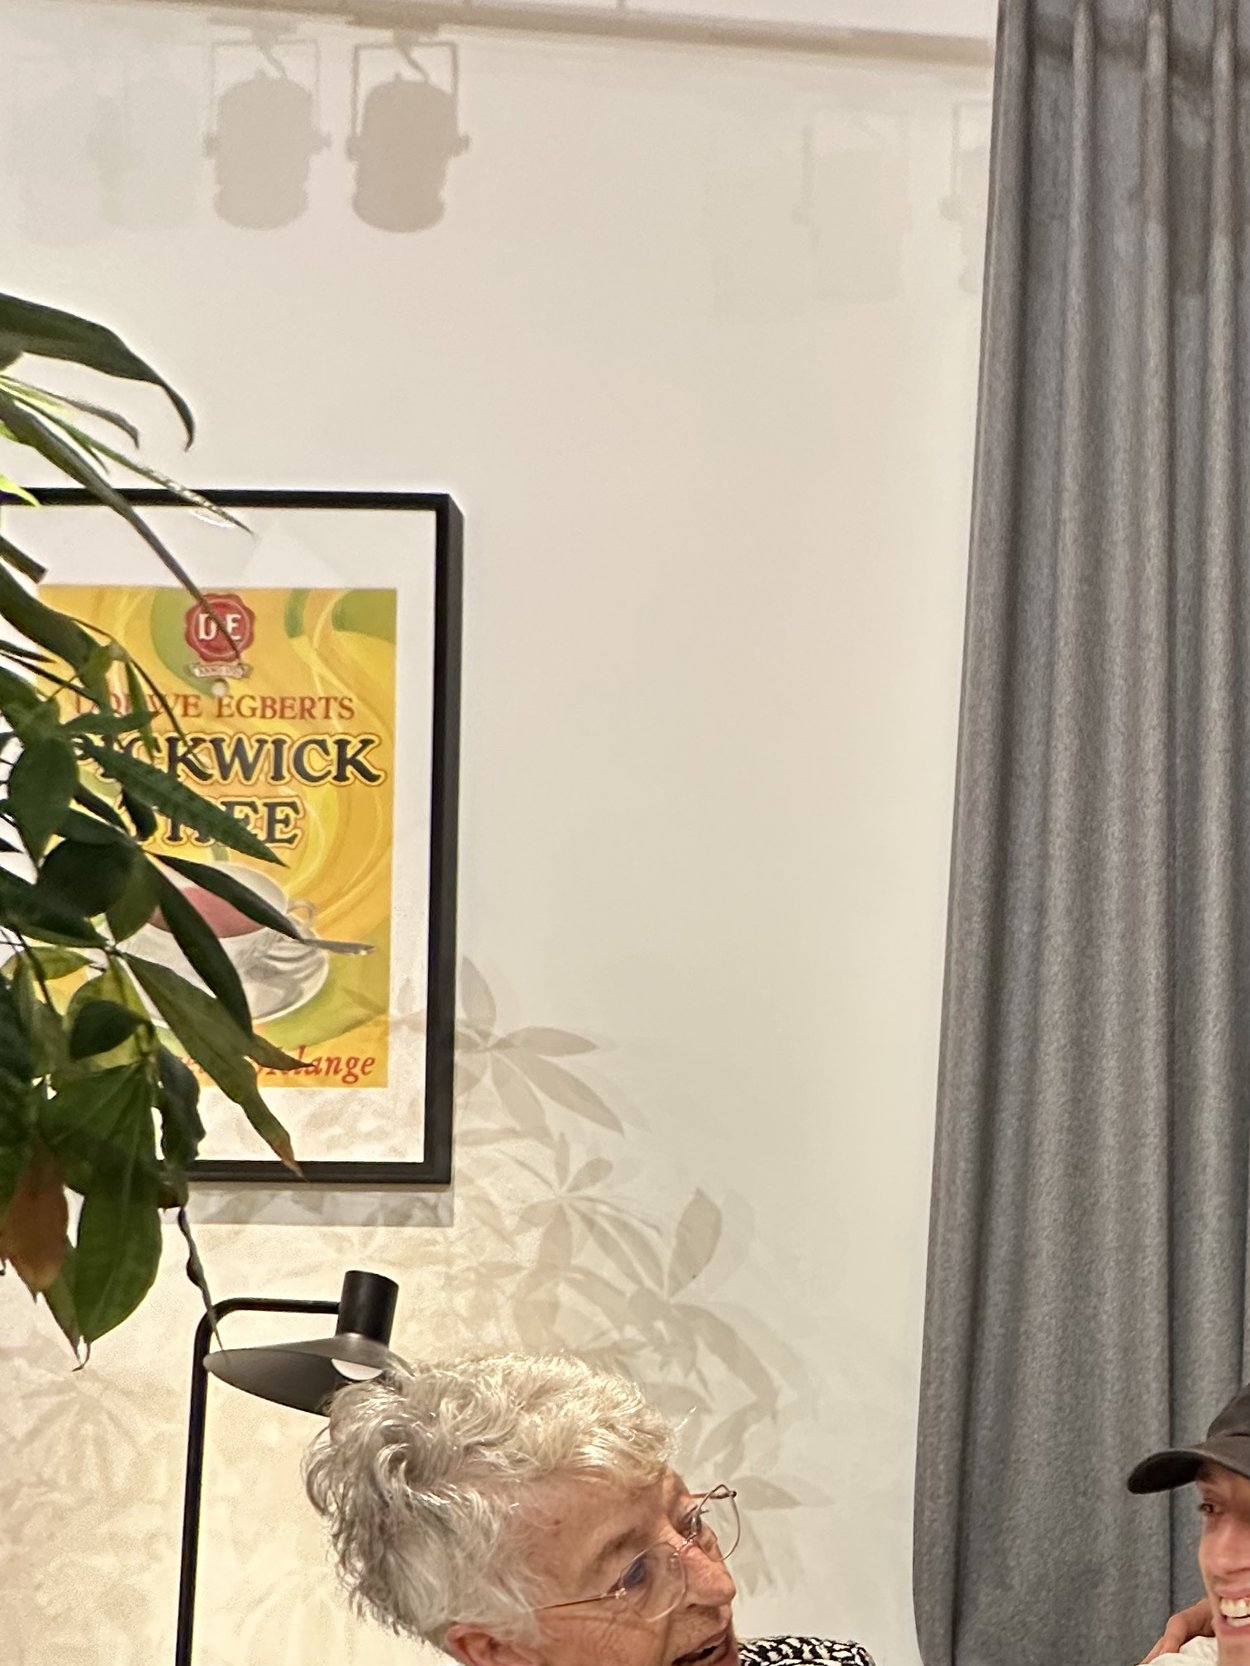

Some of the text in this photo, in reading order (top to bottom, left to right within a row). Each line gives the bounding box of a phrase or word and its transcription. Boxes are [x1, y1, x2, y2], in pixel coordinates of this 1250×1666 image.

[216, 694, 355, 720] EGBERTS
[74, 736, 382, 784] KWICK
[256, 1045, 377, 1084] lange
